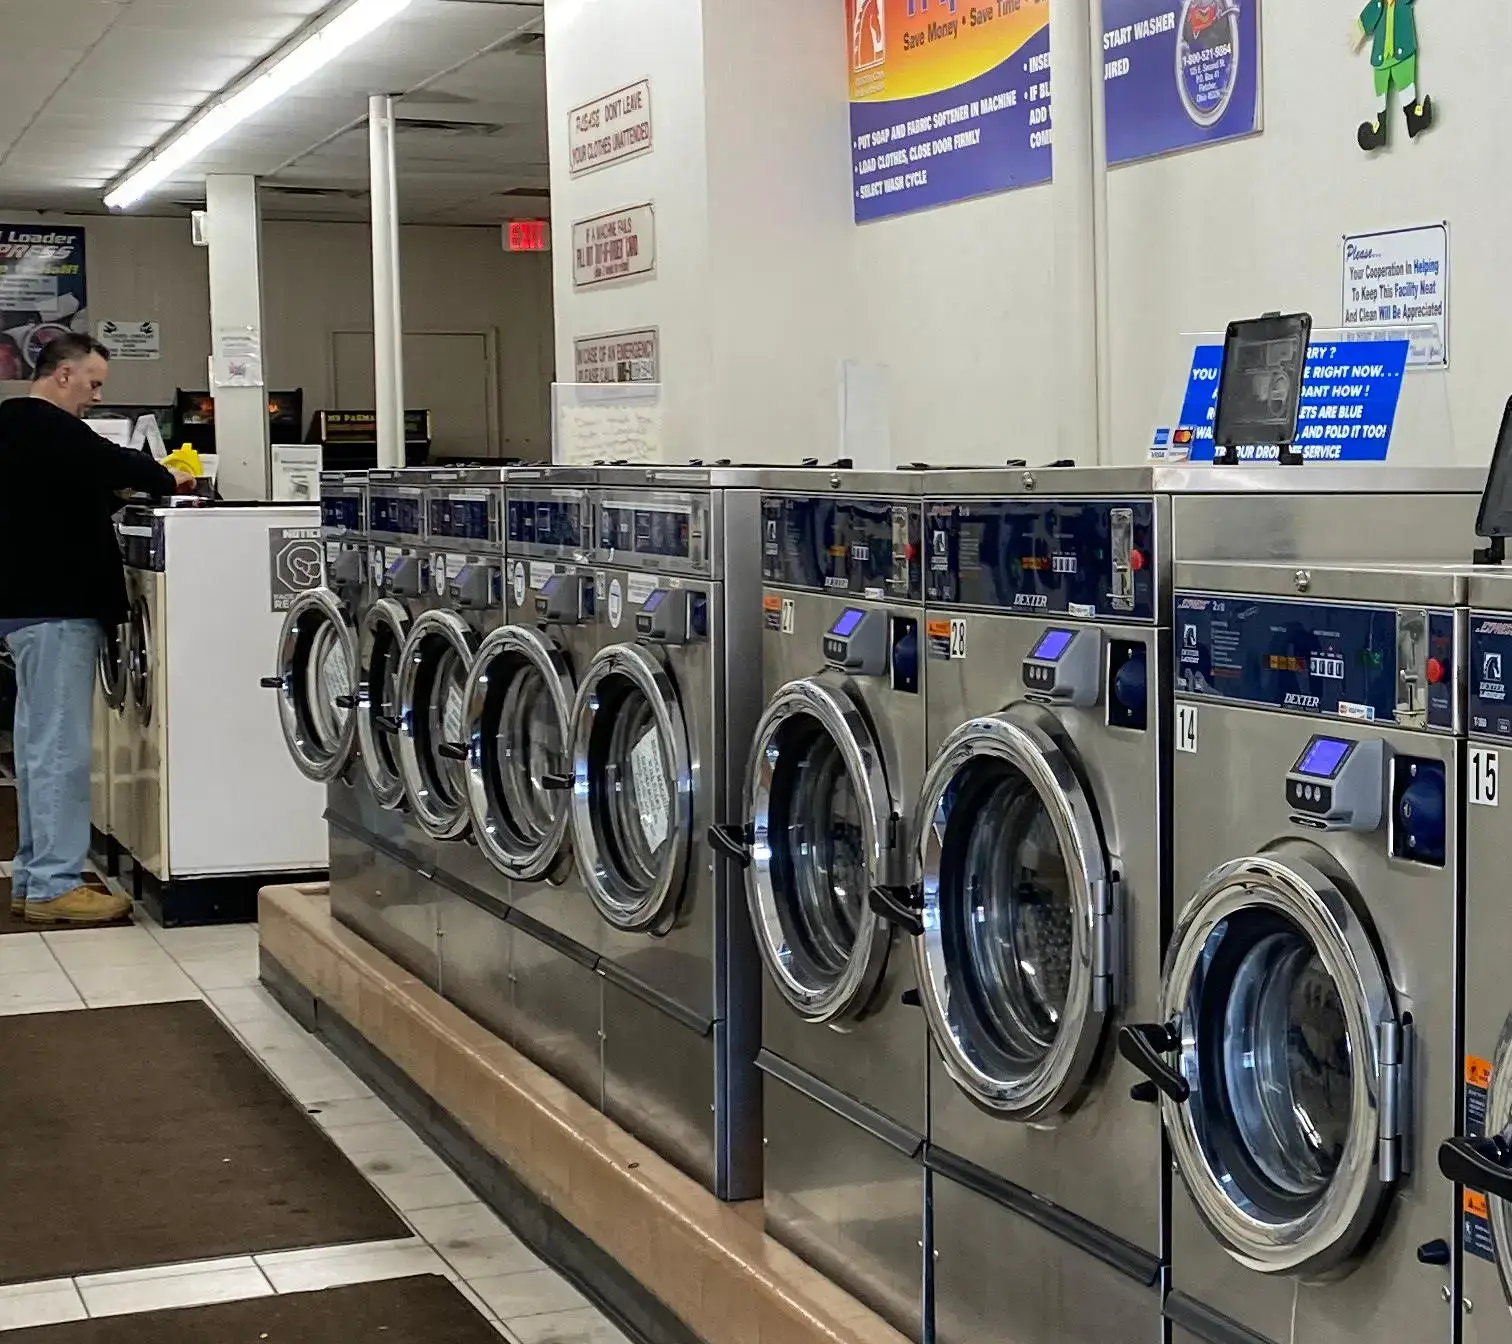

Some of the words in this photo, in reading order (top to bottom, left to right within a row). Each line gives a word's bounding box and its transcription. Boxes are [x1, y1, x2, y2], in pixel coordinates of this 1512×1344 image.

[903, 31, 925, 51] Save
[928, 19, 958, 40] Money
[970, 6, 993, 27] Save
[1103, 26, 1132, 50] START
[1134, 11, 1176, 42] WASHER
[1030, 85, 1038, 102] IF
[858, 133, 871, 150] PUT
[872, 128, 890, 147] SOAP
[891, 123, 907, 140] AND
[907, 116, 932, 136] FABRIC
[933, 104, 970, 129] SOFTENER
[970, 101, 980, 117] IN
[980, 89, 1017, 115] MACHINE
[1029, 106, 1047, 126] ADD
[859, 157, 877, 175] LOAD
[909, 141, 932, 162] CLOSE
[932, 136, 953, 155] DOOR
[953, 128, 981, 150] FIRMLY
[859, 181, 883, 199] SELECT
[884, 175, 905, 194] WASH
[905, 169, 928, 189] CYCLE
[8, 231, 77, 244] Loader
[1349, 267, 1364, 281] Your
[1365, 262, 1404, 282] Cooperation
[1406, 260, 1412, 275] In
[1413, 259, 1440, 277] Helping
[1352, 287, 1360, 302] To
[1361, 286, 1378, 302] Keep
[1379, 283, 1393, 299] This
[1394, 281, 1418, 300] Facility
[1420, 280, 1437, 296] Neat
[1345, 308, 1358, 323] And
[1359, 306, 1378, 321] Clean
[1379, 305, 1391, 320] Will
[1392, 304, 1401, 319] Be
[1402, 301, 1443, 322] Appreciated
[1192, 368, 1217, 381] YOU
[1313, 366, 1349, 379] RIGHT
[1331, 385, 1362, 398] HOW
[1318, 406, 1338, 419] ARE
[1339, 405, 1364, 419] BLUE
[1302, 425, 1323, 439] AND
[1324, 424, 1350, 438] FOLD
[1350, 424, 1361, 438] IT
[1362, 423, 1387, 438] TOO!
[1303, 445, 1342, 460] SERVICE
[1284, 693, 1320, 708] DEXTER
[1179, 709, 1195, 749] 14
[1472, 753, 1497, 802] 15
